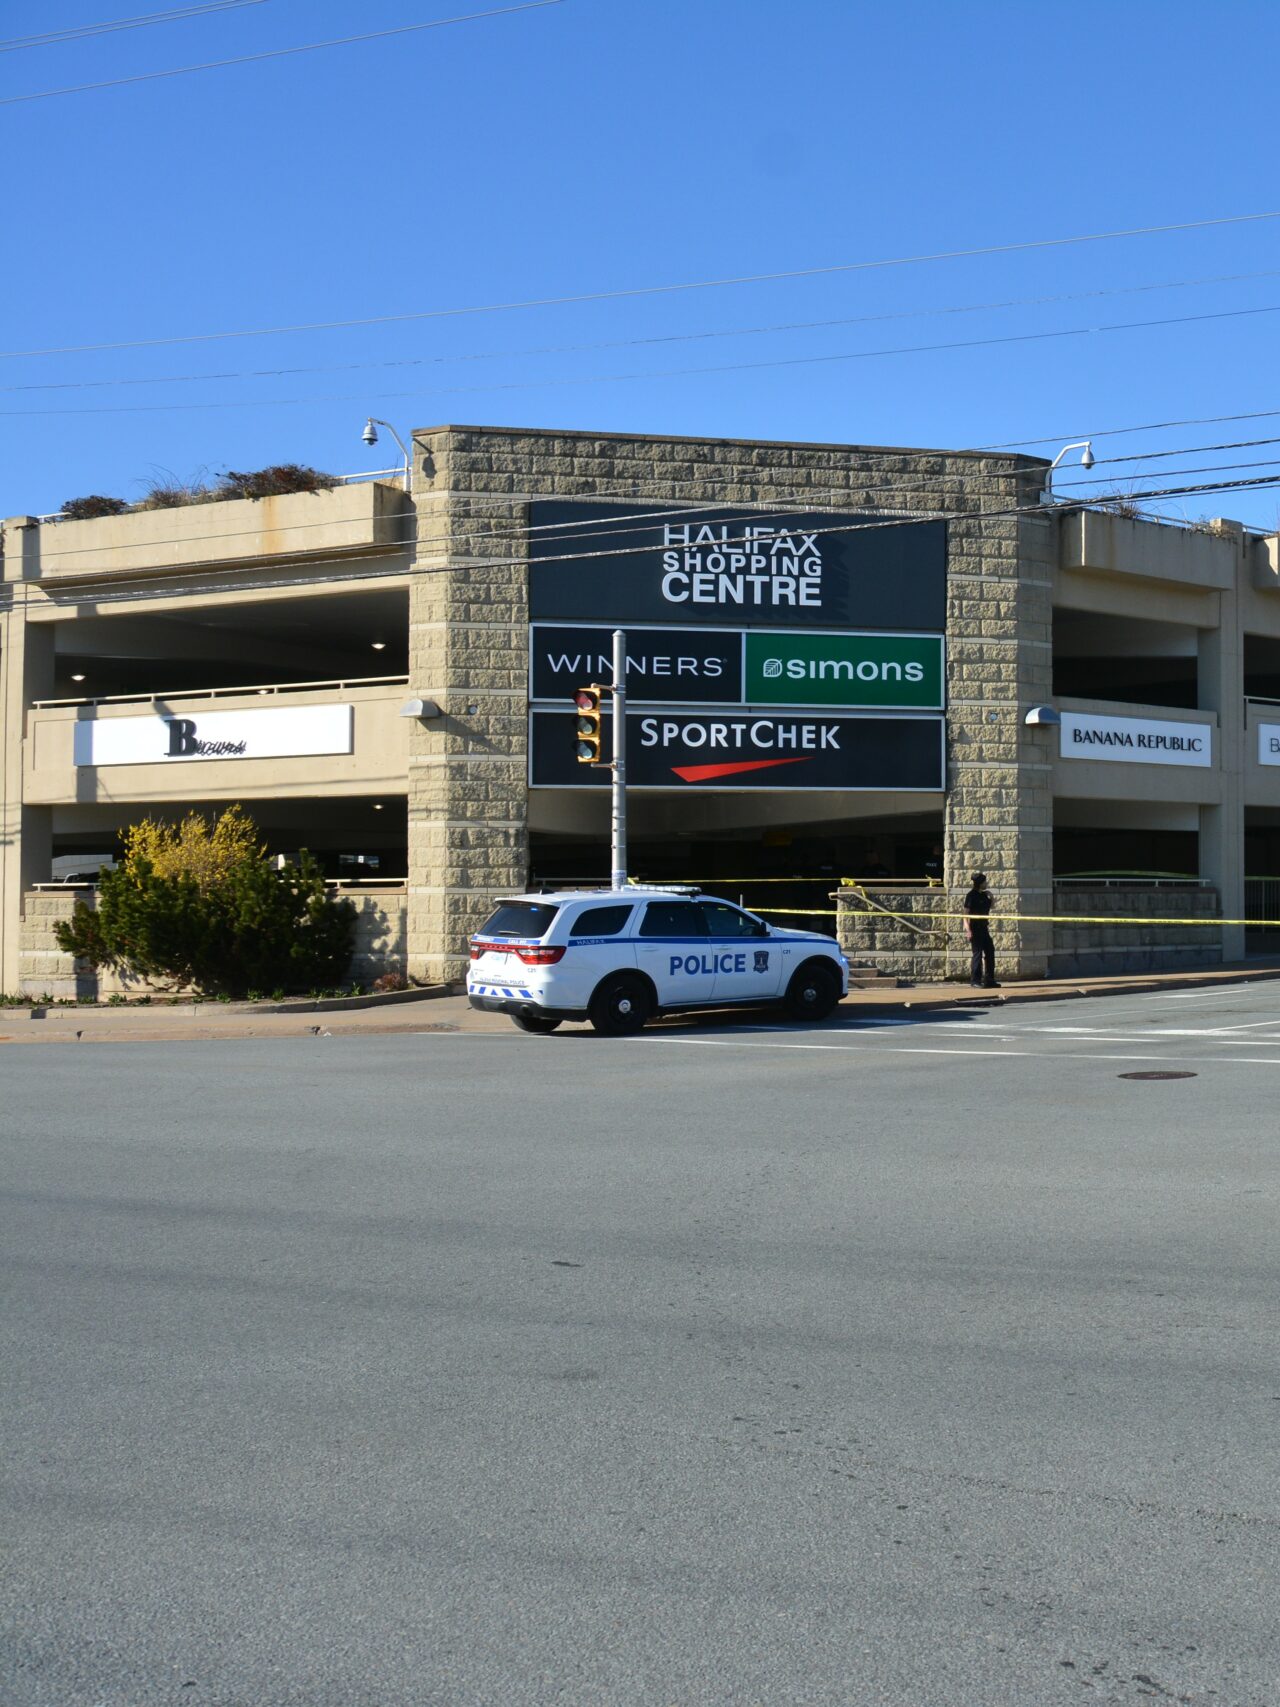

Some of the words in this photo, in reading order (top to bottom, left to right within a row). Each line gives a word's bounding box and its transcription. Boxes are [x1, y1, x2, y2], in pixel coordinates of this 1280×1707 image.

[664, 524, 822, 556] HALIFAX
[663, 551, 822, 577] SHOPPING
[661, 571, 822, 606] CENTRE
[547, 654, 727, 677] WINNERS
[786, 659, 924, 682] simons
[1073, 728, 1133, 747] BANANA
[1137, 733, 1203, 752] REPUBLIC
[669, 953, 747, 976] POLICE
